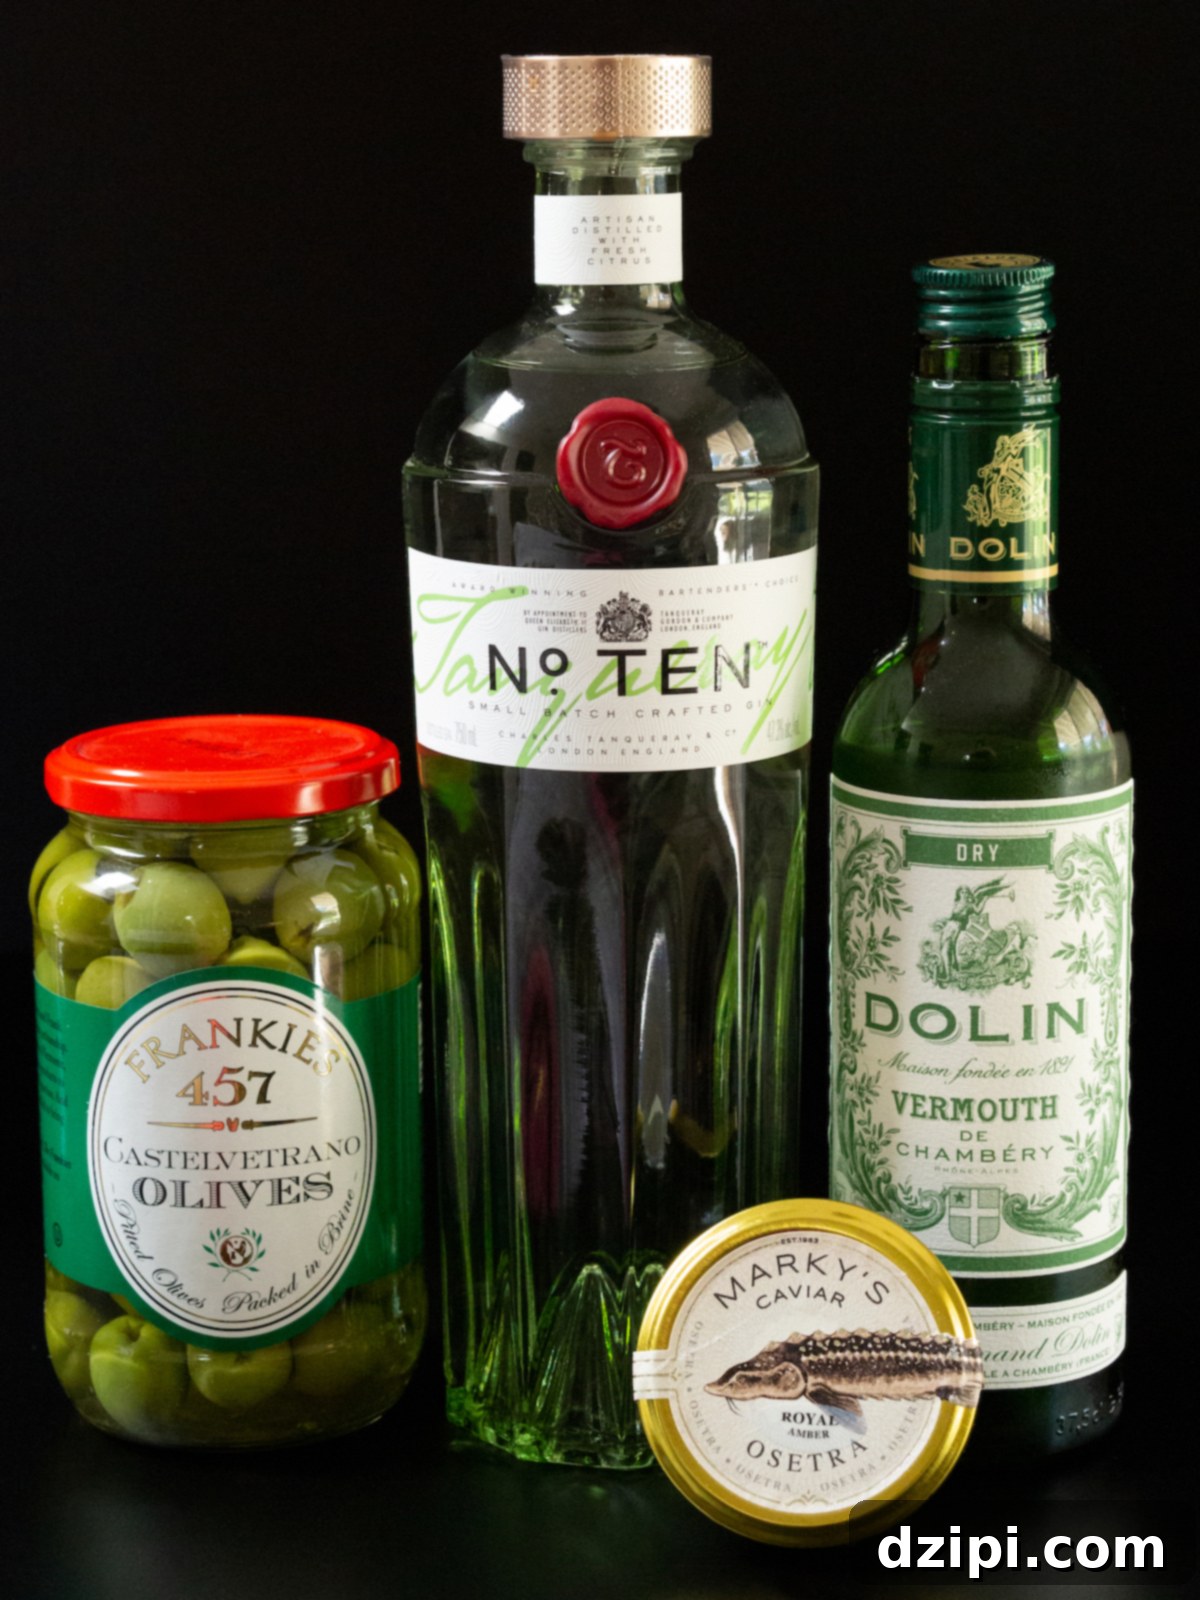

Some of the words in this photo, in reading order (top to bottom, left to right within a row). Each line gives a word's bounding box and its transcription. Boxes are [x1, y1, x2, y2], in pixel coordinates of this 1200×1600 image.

[581, 215, 655, 224] ARTISAN
[571, 225, 662, 235] DISTILLED
[598, 236, 640, 244] WITH
[591, 246, 647, 255] FRESH
[587, 257, 651, 266] CITRUS
[949, 532, 1056, 561] DOLIN
[597, 642, 750, 696] TEN
[468, 701, 526, 715] SMALL
[544, 708, 616, 718] BATCH
[635, 704, 732, 718] CRAFTED
[746, 698, 773, 710] GIN
[498, 730, 572, 742] CHARLES
[588, 733, 692, 744] TANQUERAY
[537, 747, 608, 756] LONDON
[620, 745, 700, 756] ENGLAND
[956, 843, 1000, 862] DRY
[865, 991, 1088, 1045] DOLIN
[124, 1017, 341, 1084] FRANKIES
[878, 1051, 950, 1078] Maison
[944, 1057, 1010, 1084] fondée
[1015, 1067, 1034, 1078] en
[176, 1066, 276, 1107] 457
[891, 1089, 1060, 1122] VERMOUTH
[959, 1130, 988, 1142] DE
[896, 1144, 1054, 1163] CHAMBÉRY
[132, 1171, 334, 1209] OLIVES
[152, 1266, 206, 1310] Olives
[221, 1272, 298, 1315] Packed
[304, 1258, 321, 1279] in
[318, 1187, 356, 1255] Brine
[713, 1252, 890, 1310] MARKY'S
[756, 1284, 845, 1310] CAVIAR
[974, 1321, 1015, 1332] MBÉRY
[1027, 1316, 1070, 1329] MAISON
[1013, 1361, 1074, 1378] CHAMBÉRY
[781, 1411, 840, 1427] ROYAL
[787, 1427, 830, 1439] AMBER
[735, 1463, 792, 1493] OSETRA
[819, 1462, 877, 1493] OSETRA
[888, 1398, 918, 1451] OSETR
[746, 1439, 869, 1473] OSETRA
